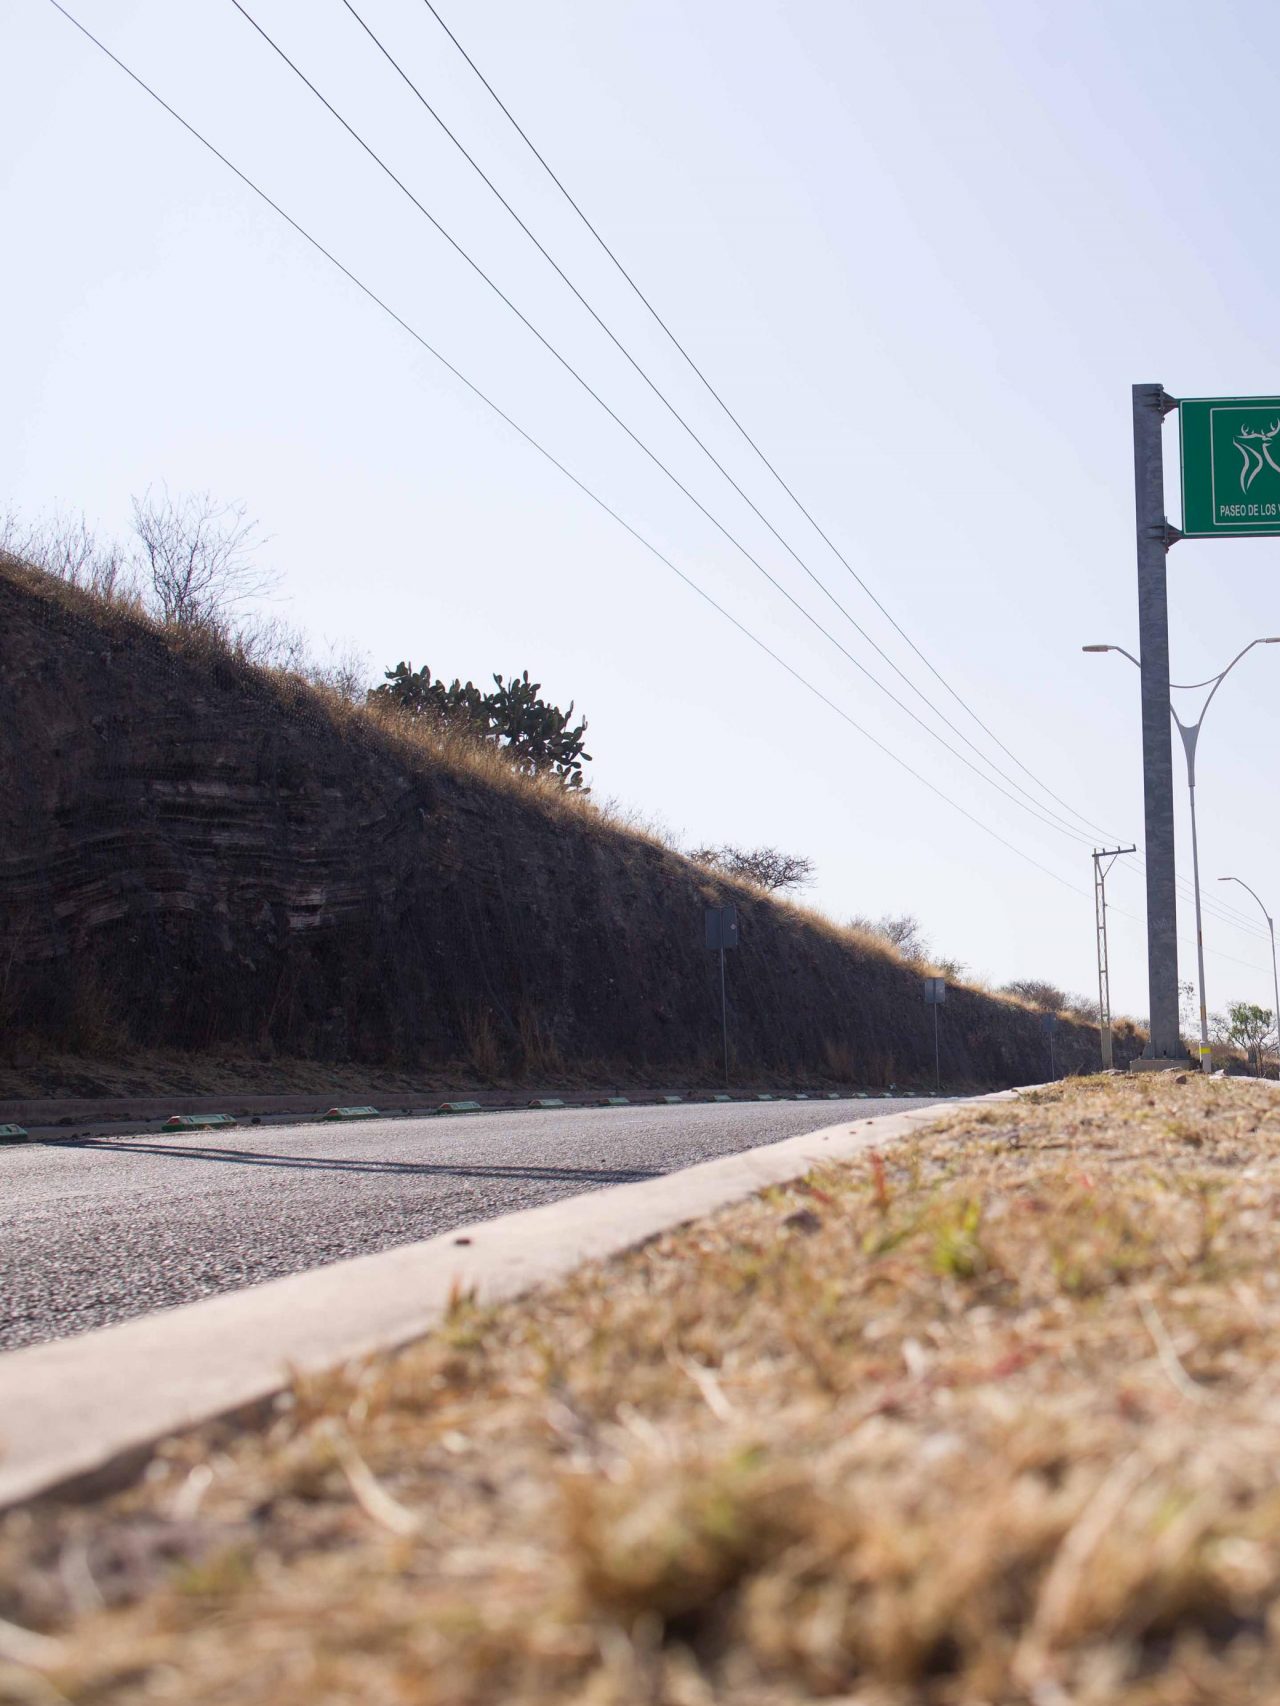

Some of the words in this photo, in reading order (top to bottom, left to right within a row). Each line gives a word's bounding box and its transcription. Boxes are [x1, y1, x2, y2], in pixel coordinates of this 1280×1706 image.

[1220, 504, 1247, 517] PASEO
[1248, 504, 1259, 516] DE
[1260, 503, 1276, 516] LOS
